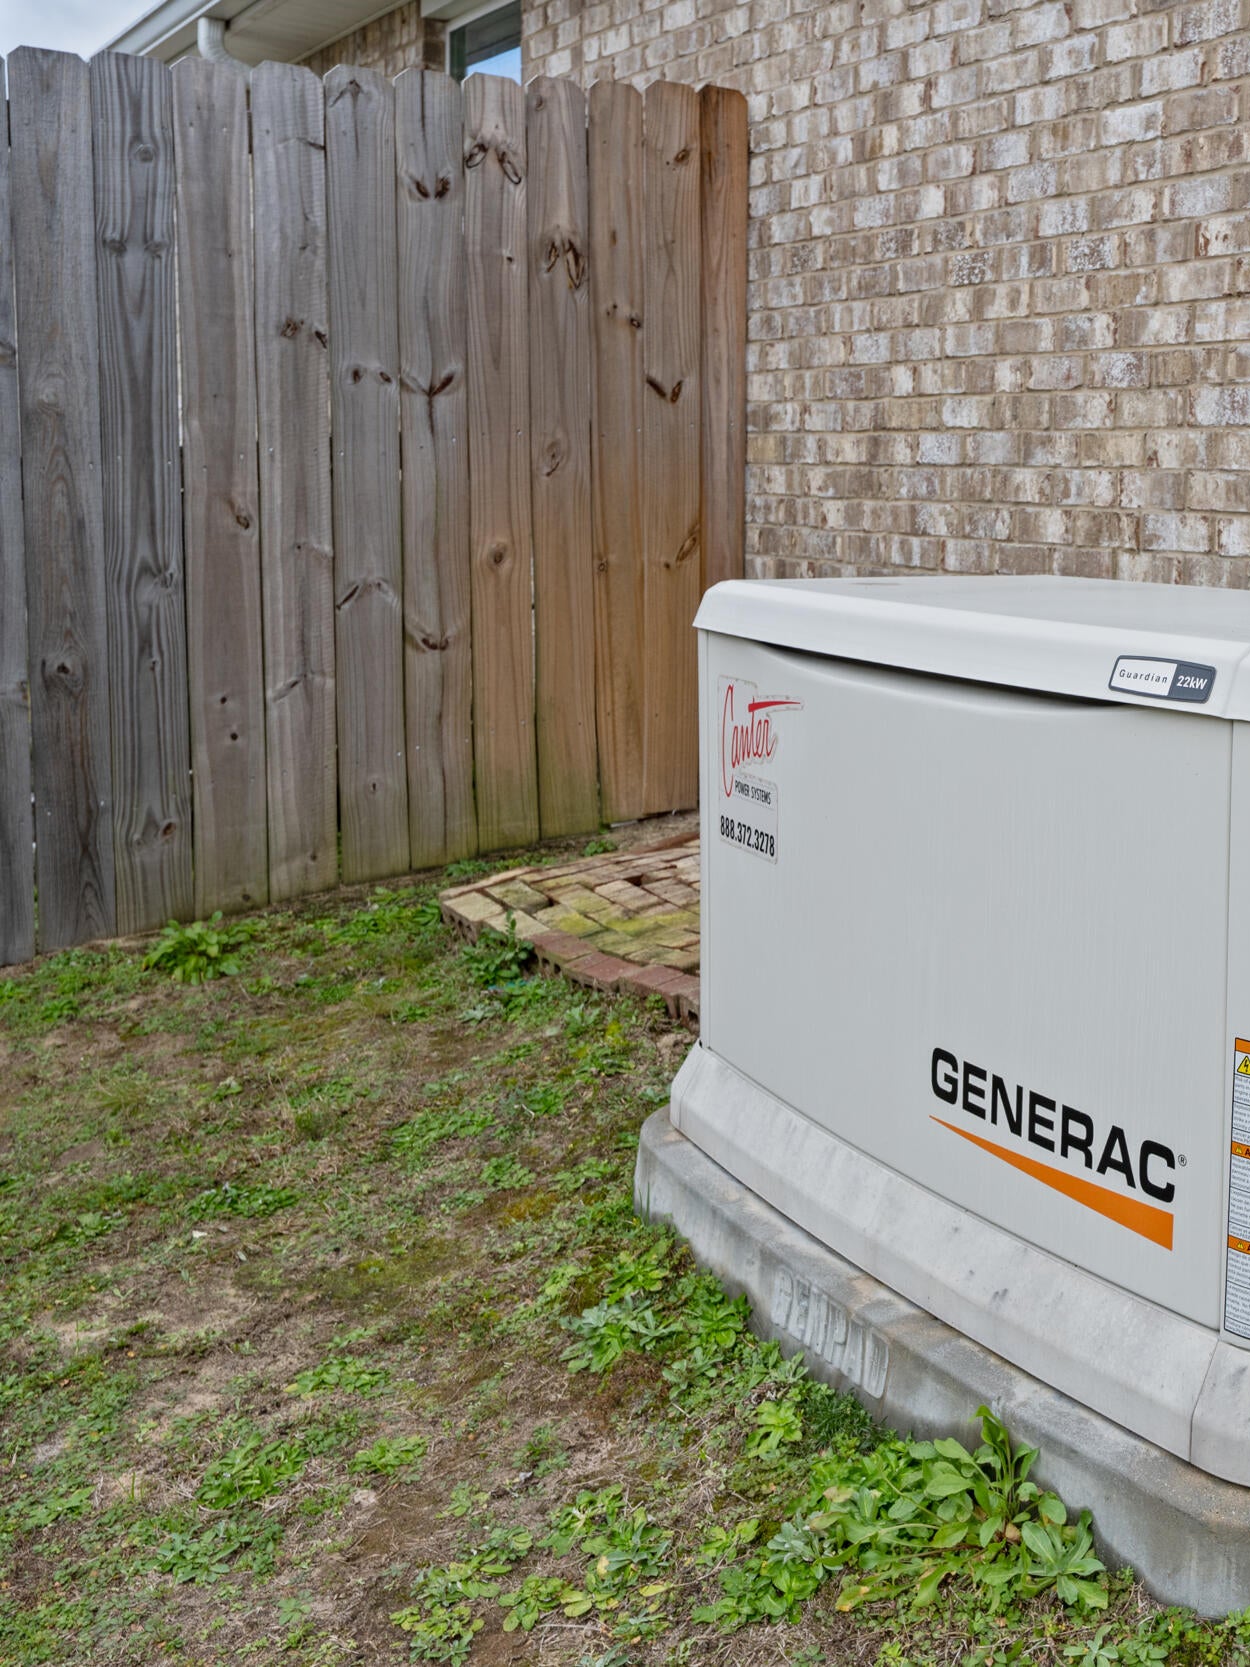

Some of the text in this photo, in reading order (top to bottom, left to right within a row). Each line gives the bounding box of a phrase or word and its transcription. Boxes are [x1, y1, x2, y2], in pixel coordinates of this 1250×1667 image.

[1119, 669, 1208, 690] Guardian 22kW
[734, 780, 772, 804] POWER SYSTEMS
[720, 815, 776, 857] 888.372.3278
